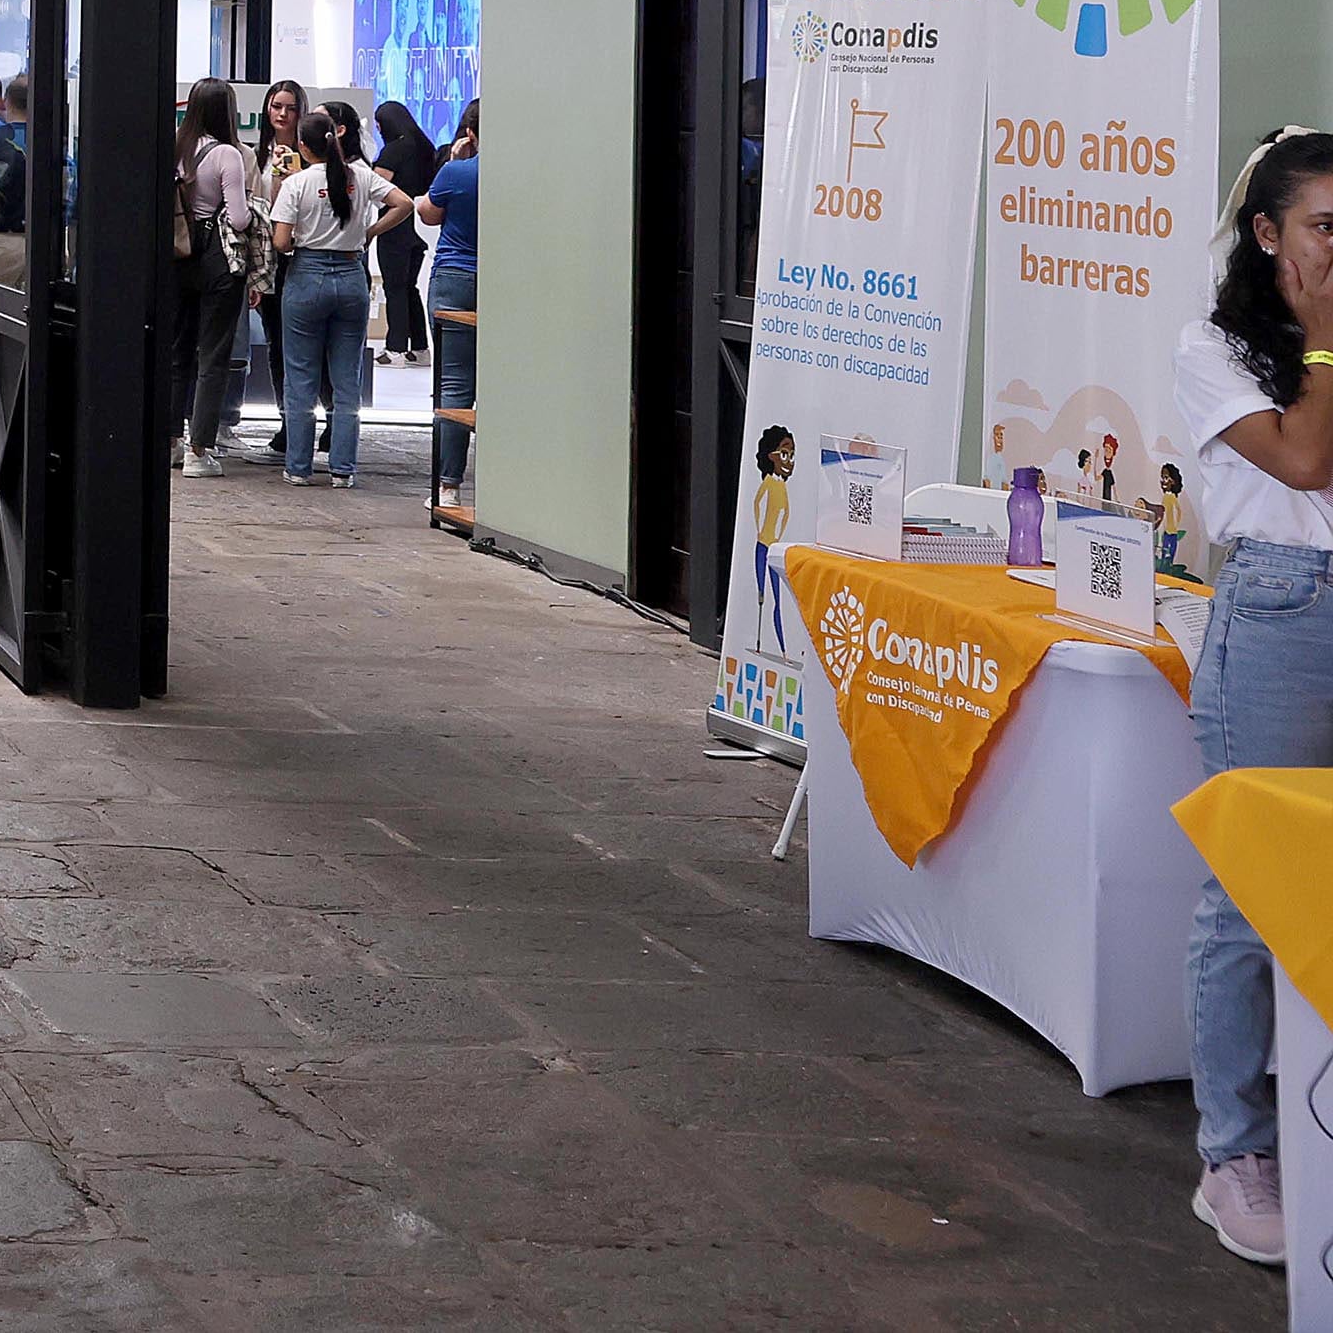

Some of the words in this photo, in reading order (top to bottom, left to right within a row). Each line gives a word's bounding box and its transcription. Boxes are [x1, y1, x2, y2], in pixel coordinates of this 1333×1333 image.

[831, 21, 939, 53] Conapdis
[830, 54, 858, 64] Consejo
[858, 53, 889, 63] Nacional
[890, 55, 900, 63] de
[901, 55, 935, 64] Personas
[842, 65, 888, 74] Discapacidad
[994, 118, 1066, 169] 200
[1079, 120, 1176, 177] años
[813, 184, 883, 222] 2008
[1000, 185, 1173, 239] eliminando
[778, 258, 817, 291] Ley
[820, 264, 855, 292] No.
[863, 269, 918, 301] 8661
[1020, 243, 1151, 298] barreras
[826, 298, 843, 317] de
[848, 300, 860, 319] la
[864, 303, 942, 332] Convención
[761, 317, 799, 336] sobre
[803, 320, 819, 340] los
[822, 325, 884, 351] derechos
[887, 334, 906, 354] de
[910, 337, 927, 358] las
[755, 342, 813, 365] personas
[816, 352, 839, 370] con
[844, 354, 929, 386] discapacidad
[867, 617, 999, 694] Conapdis
[866, 670, 911, 693] Consejo
[866, 692, 885, 706] con
